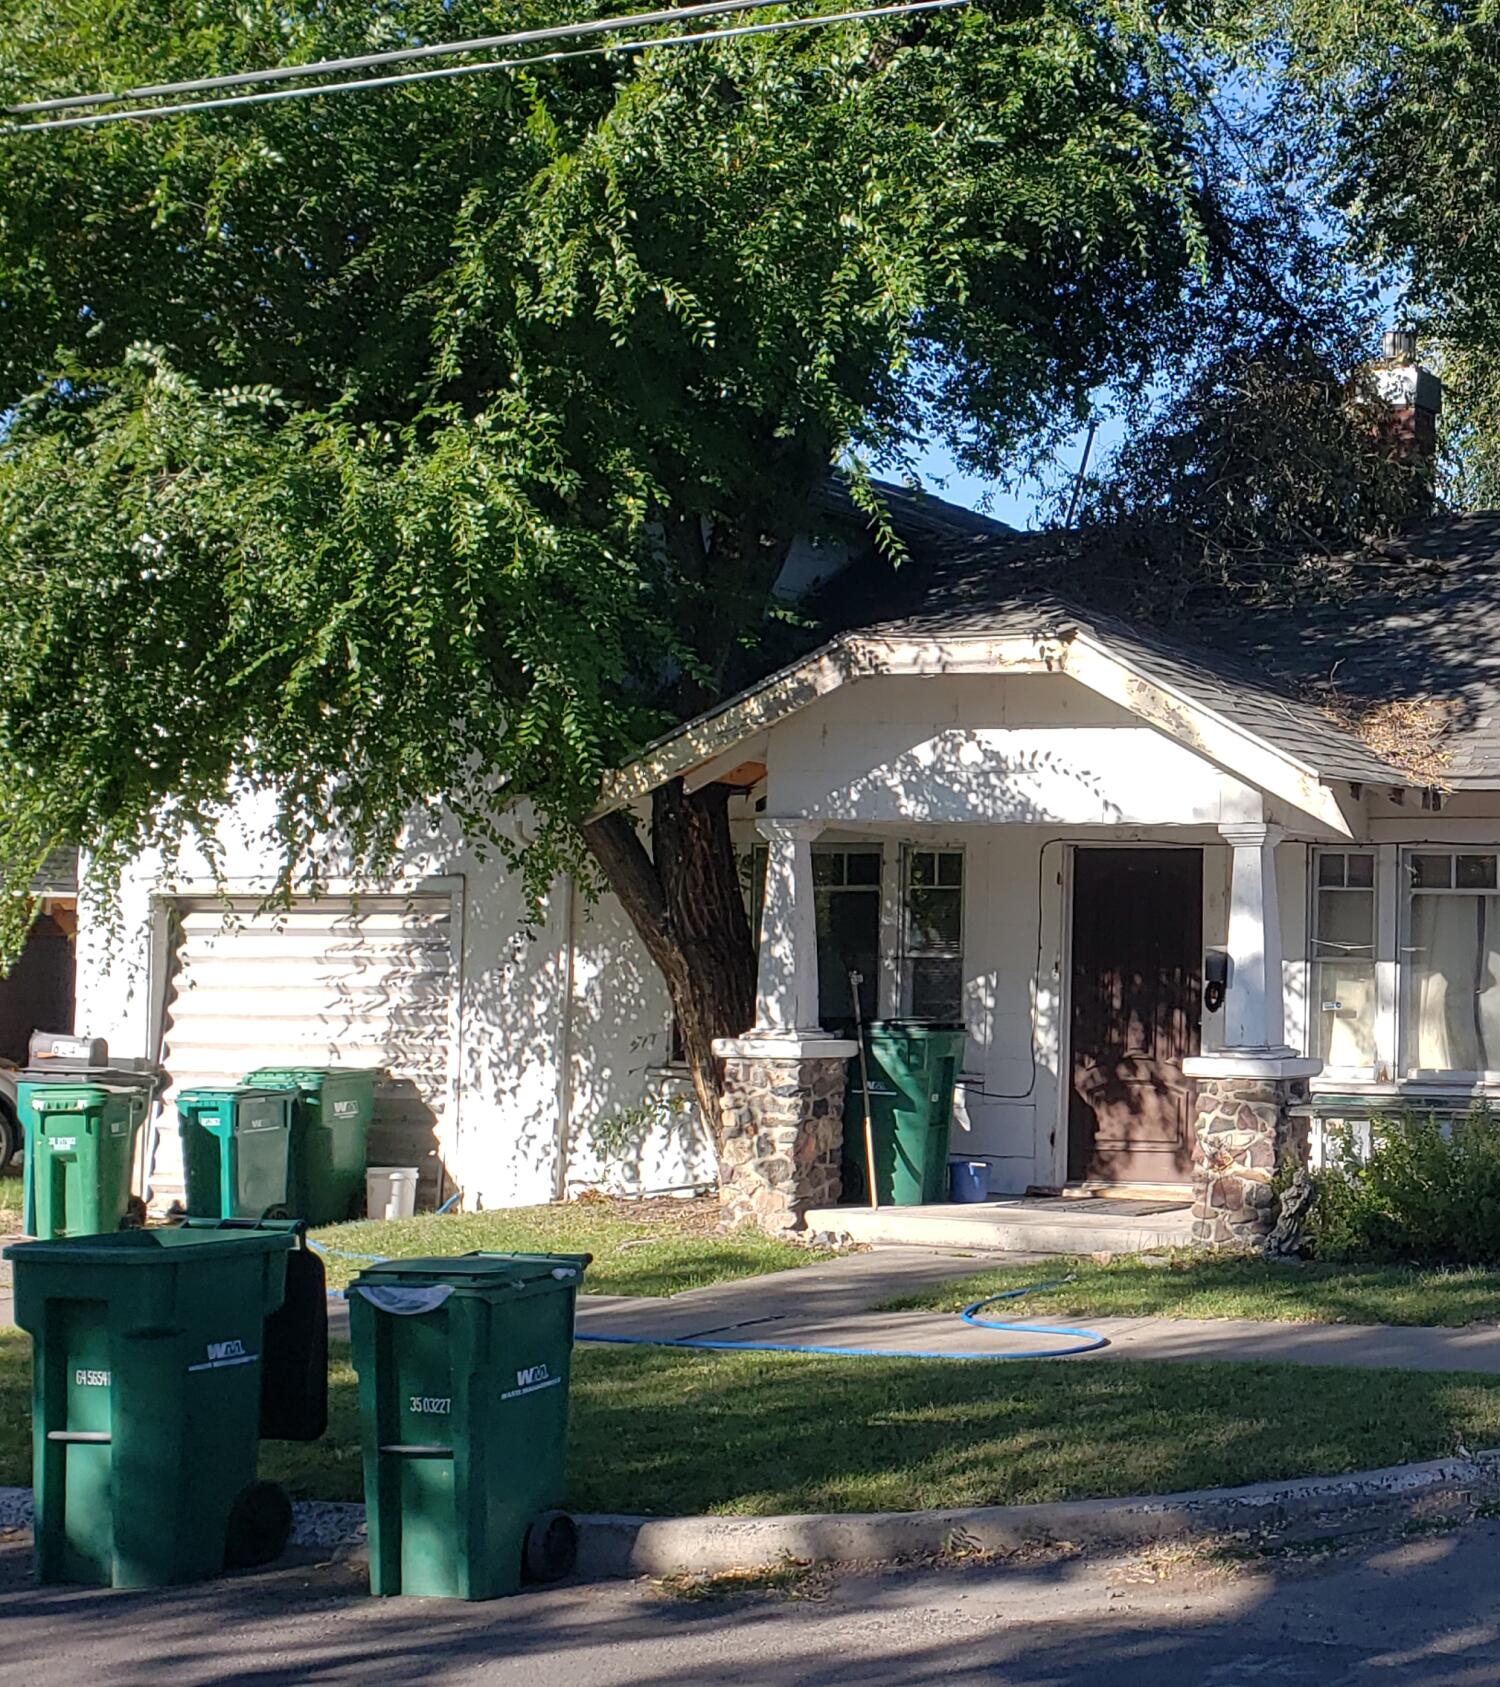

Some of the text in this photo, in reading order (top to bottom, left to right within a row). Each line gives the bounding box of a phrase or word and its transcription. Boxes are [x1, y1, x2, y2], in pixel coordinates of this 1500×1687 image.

[207, 1340, 246, 1360] WM
[517, 1363, 549, 1386] WM
[410, 1396, 422, 1412] 35
